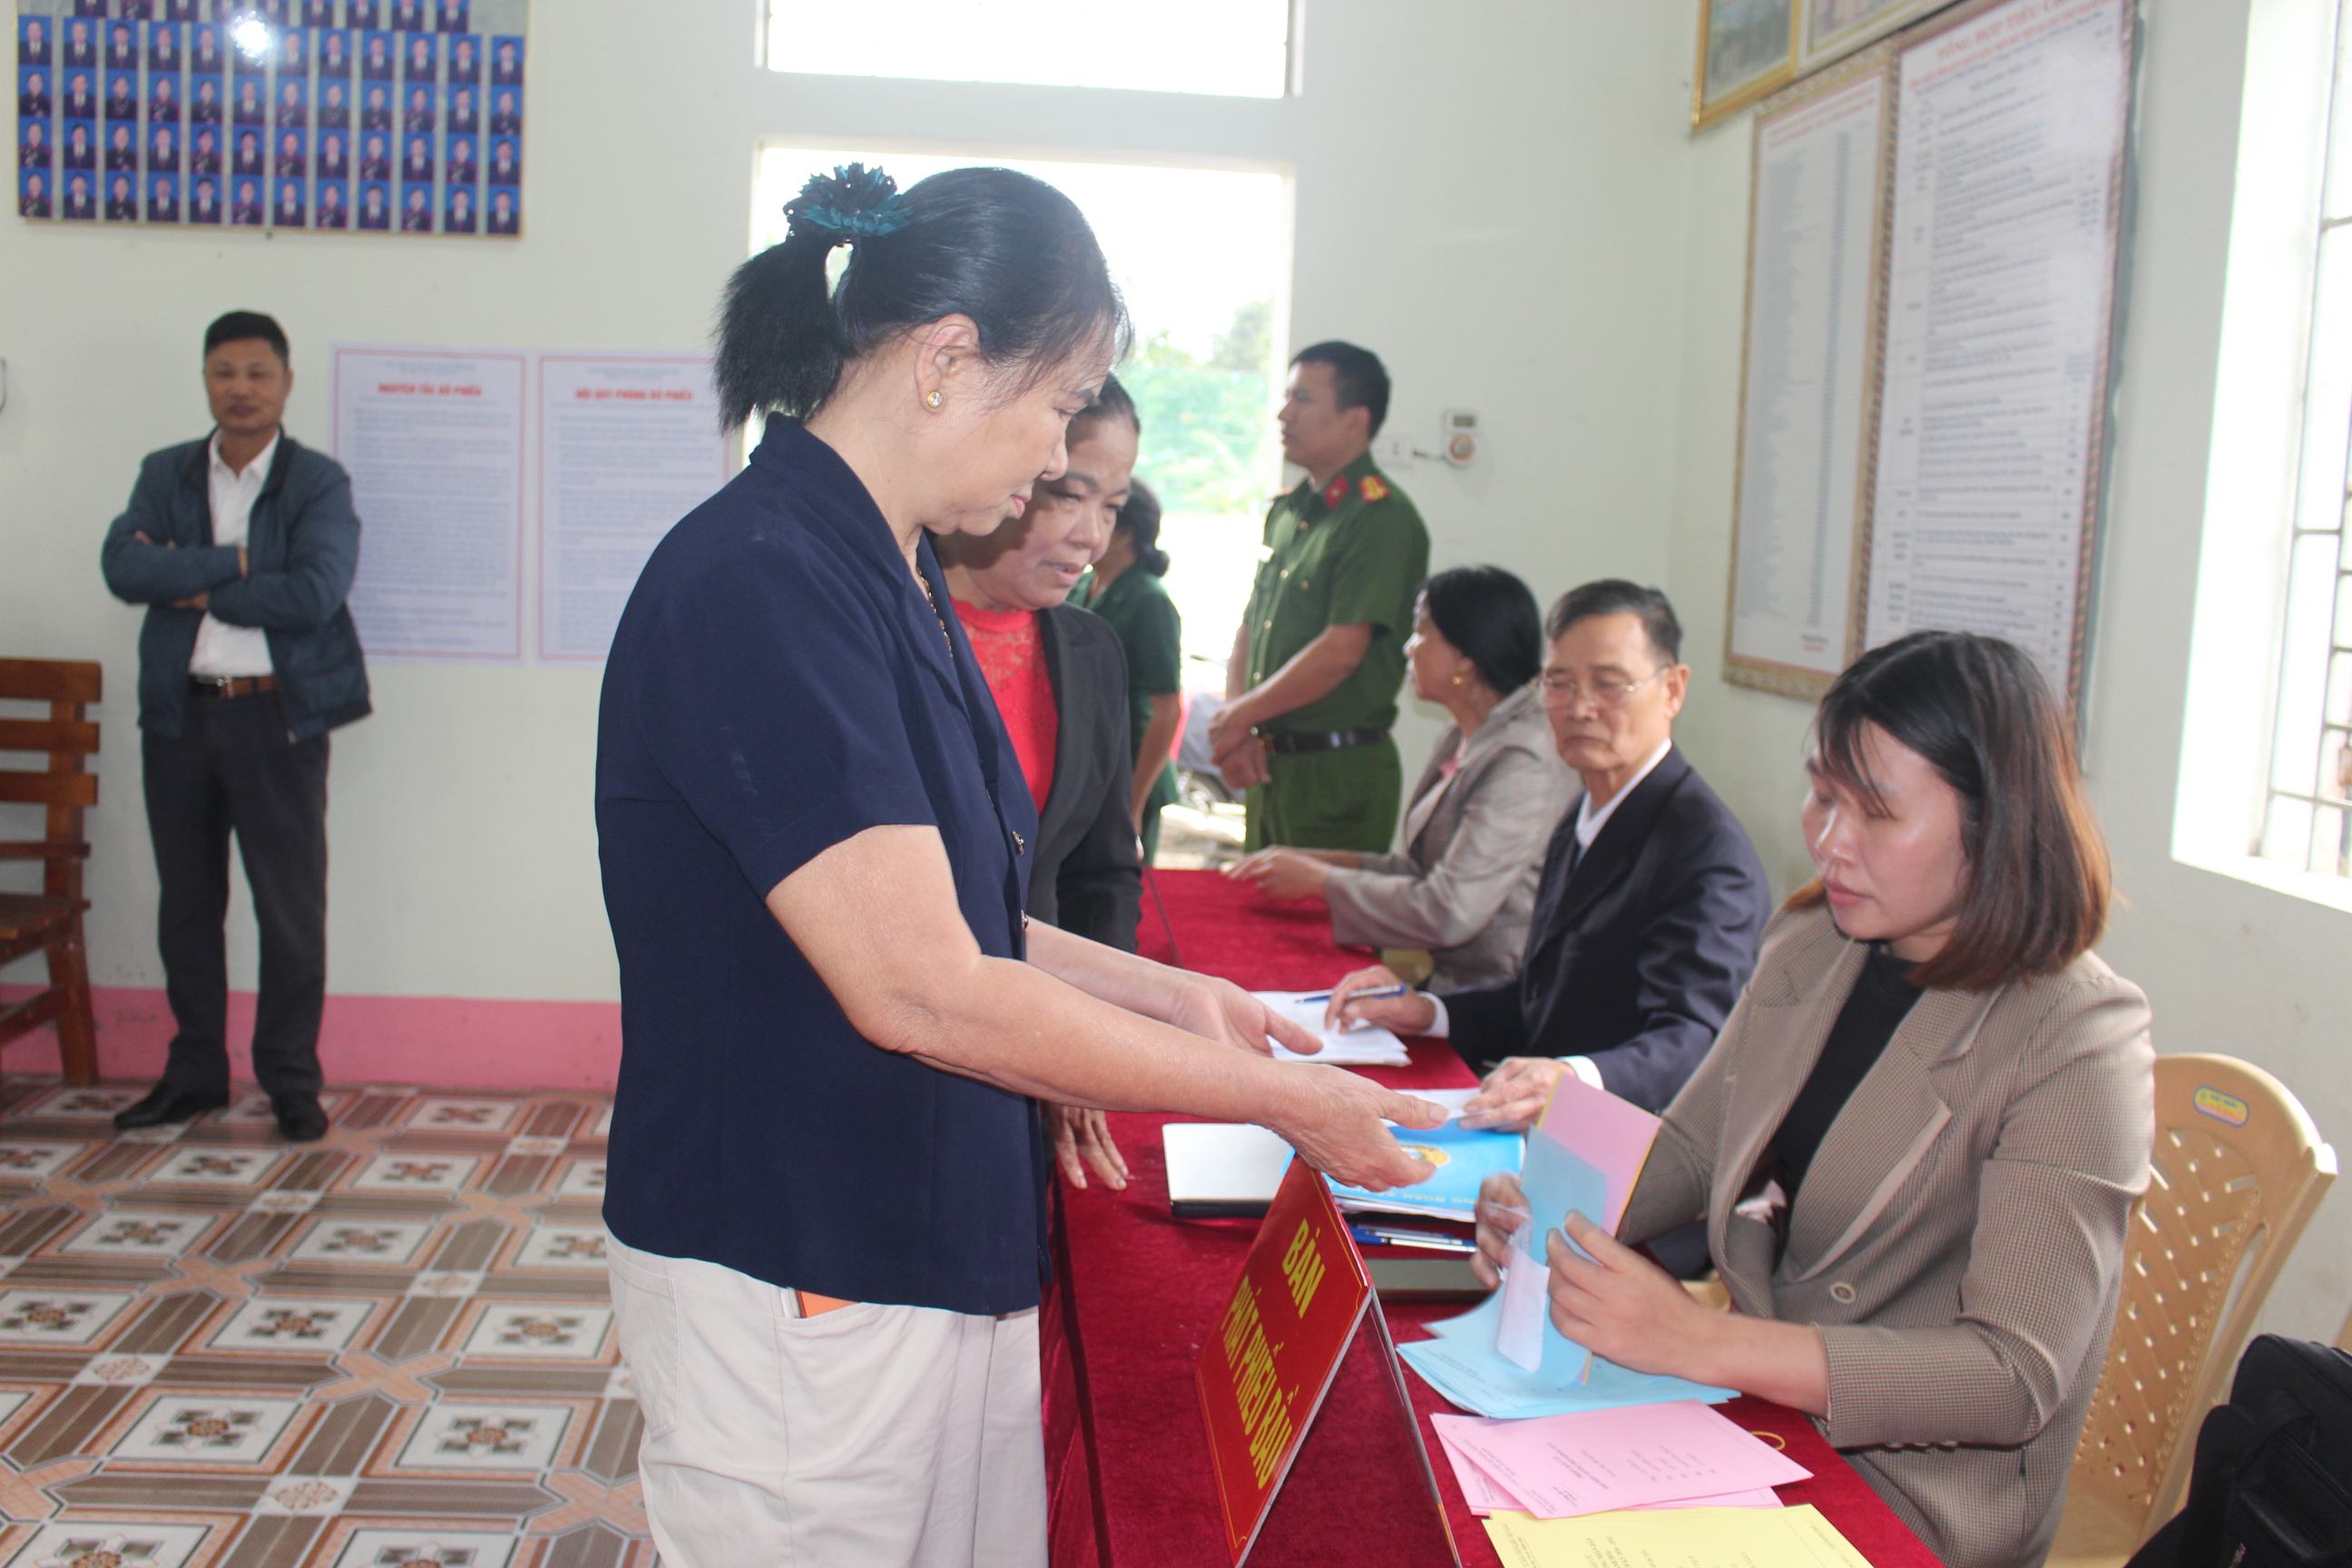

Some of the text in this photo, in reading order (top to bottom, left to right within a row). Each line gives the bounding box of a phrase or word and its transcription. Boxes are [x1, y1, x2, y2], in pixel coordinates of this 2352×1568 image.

[1281, 1218, 1326, 1319] BÀN
[1220, 1274, 1299, 1490] PHÁT PHIẾU BẦU
